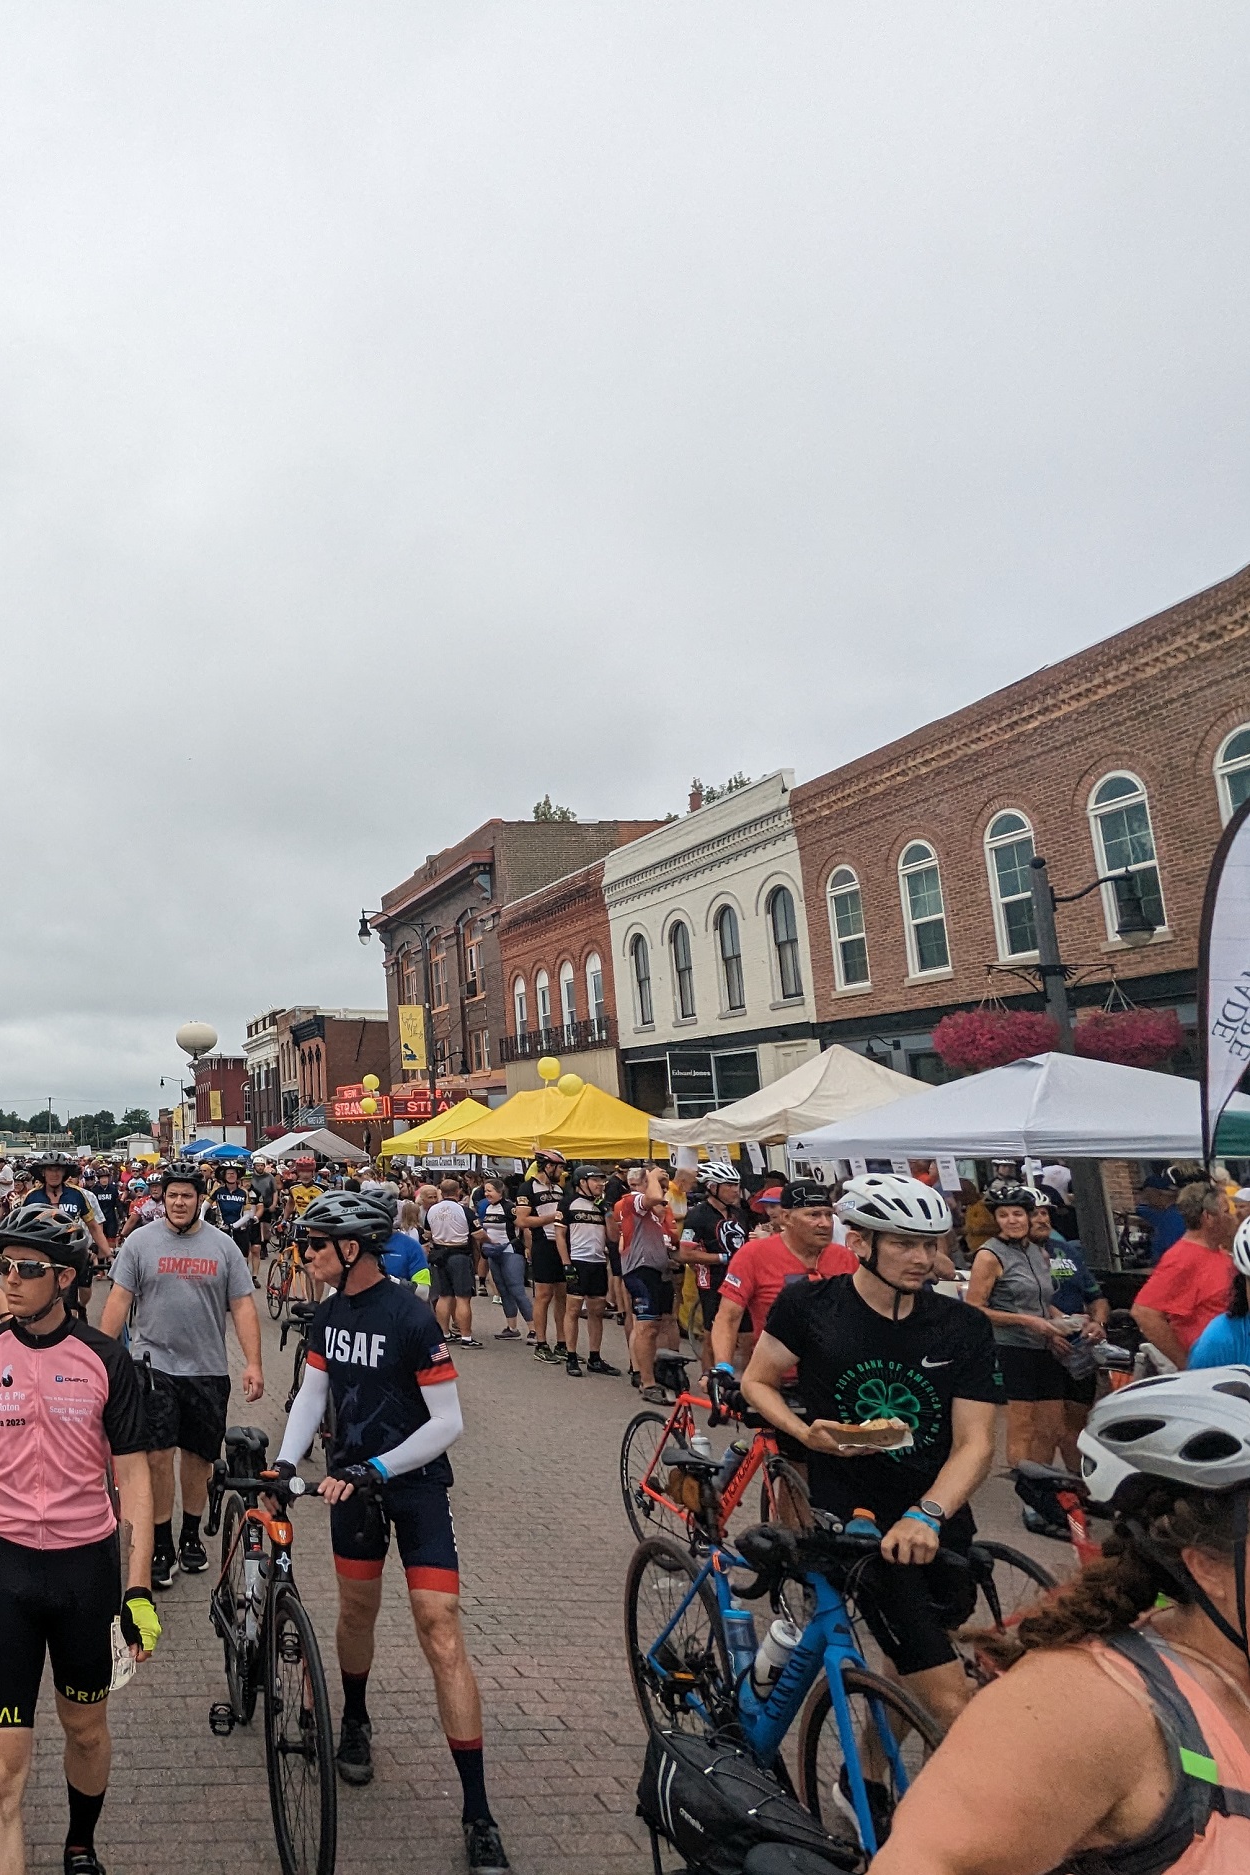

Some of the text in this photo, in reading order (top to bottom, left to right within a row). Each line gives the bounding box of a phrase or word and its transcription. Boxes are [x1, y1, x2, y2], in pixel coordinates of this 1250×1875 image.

[692, 1069, 711, 1077] Jones
[334, 1102, 367, 1116] STRAN
[59, 1204, 78, 1213] AVIS
[158, 1257, 219, 1276] SIMPSON
[325, 1326, 386, 1368] USAF
[856, 1359, 884, 1372] BANK
[889, 1361, 903, 1372] OF
[907, 1370, 941, 1409] AMERICA
[4, 1392, 10, 1400] &
[13, 1391, 26, 1400] Pie
[6, 1418, 26, 1426] 2023
[764, 1645, 814, 1720] CANYON
